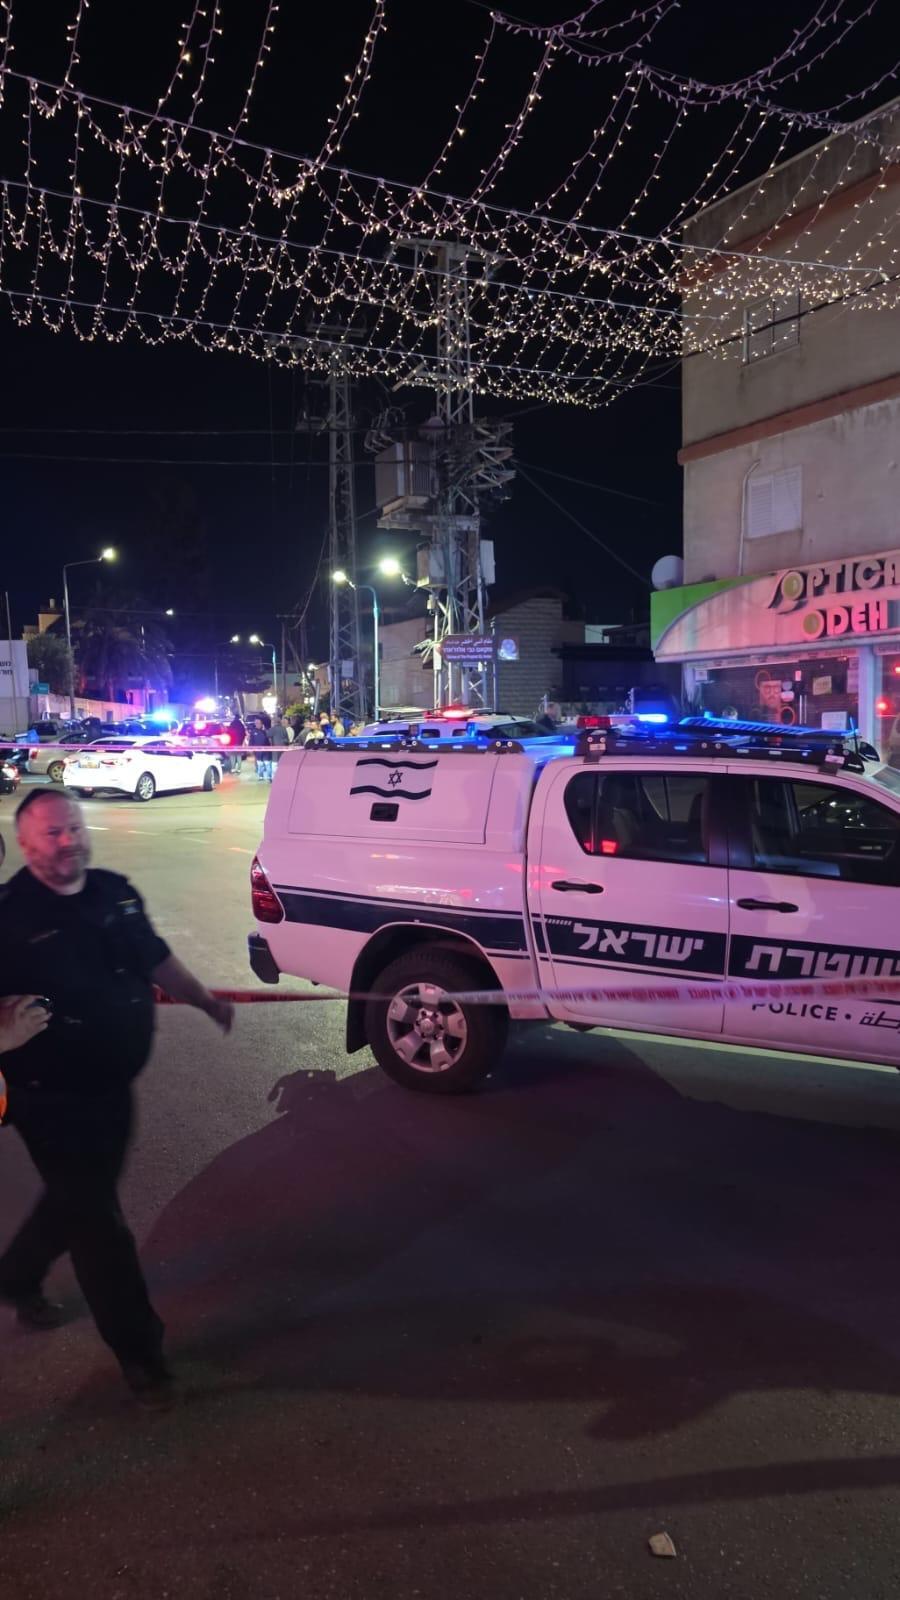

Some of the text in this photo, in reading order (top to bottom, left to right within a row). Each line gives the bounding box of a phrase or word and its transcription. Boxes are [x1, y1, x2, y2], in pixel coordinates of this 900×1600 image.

[800, 600, 888, 640] ODEH
[573, 923, 900, 978] שטרת ישראל
